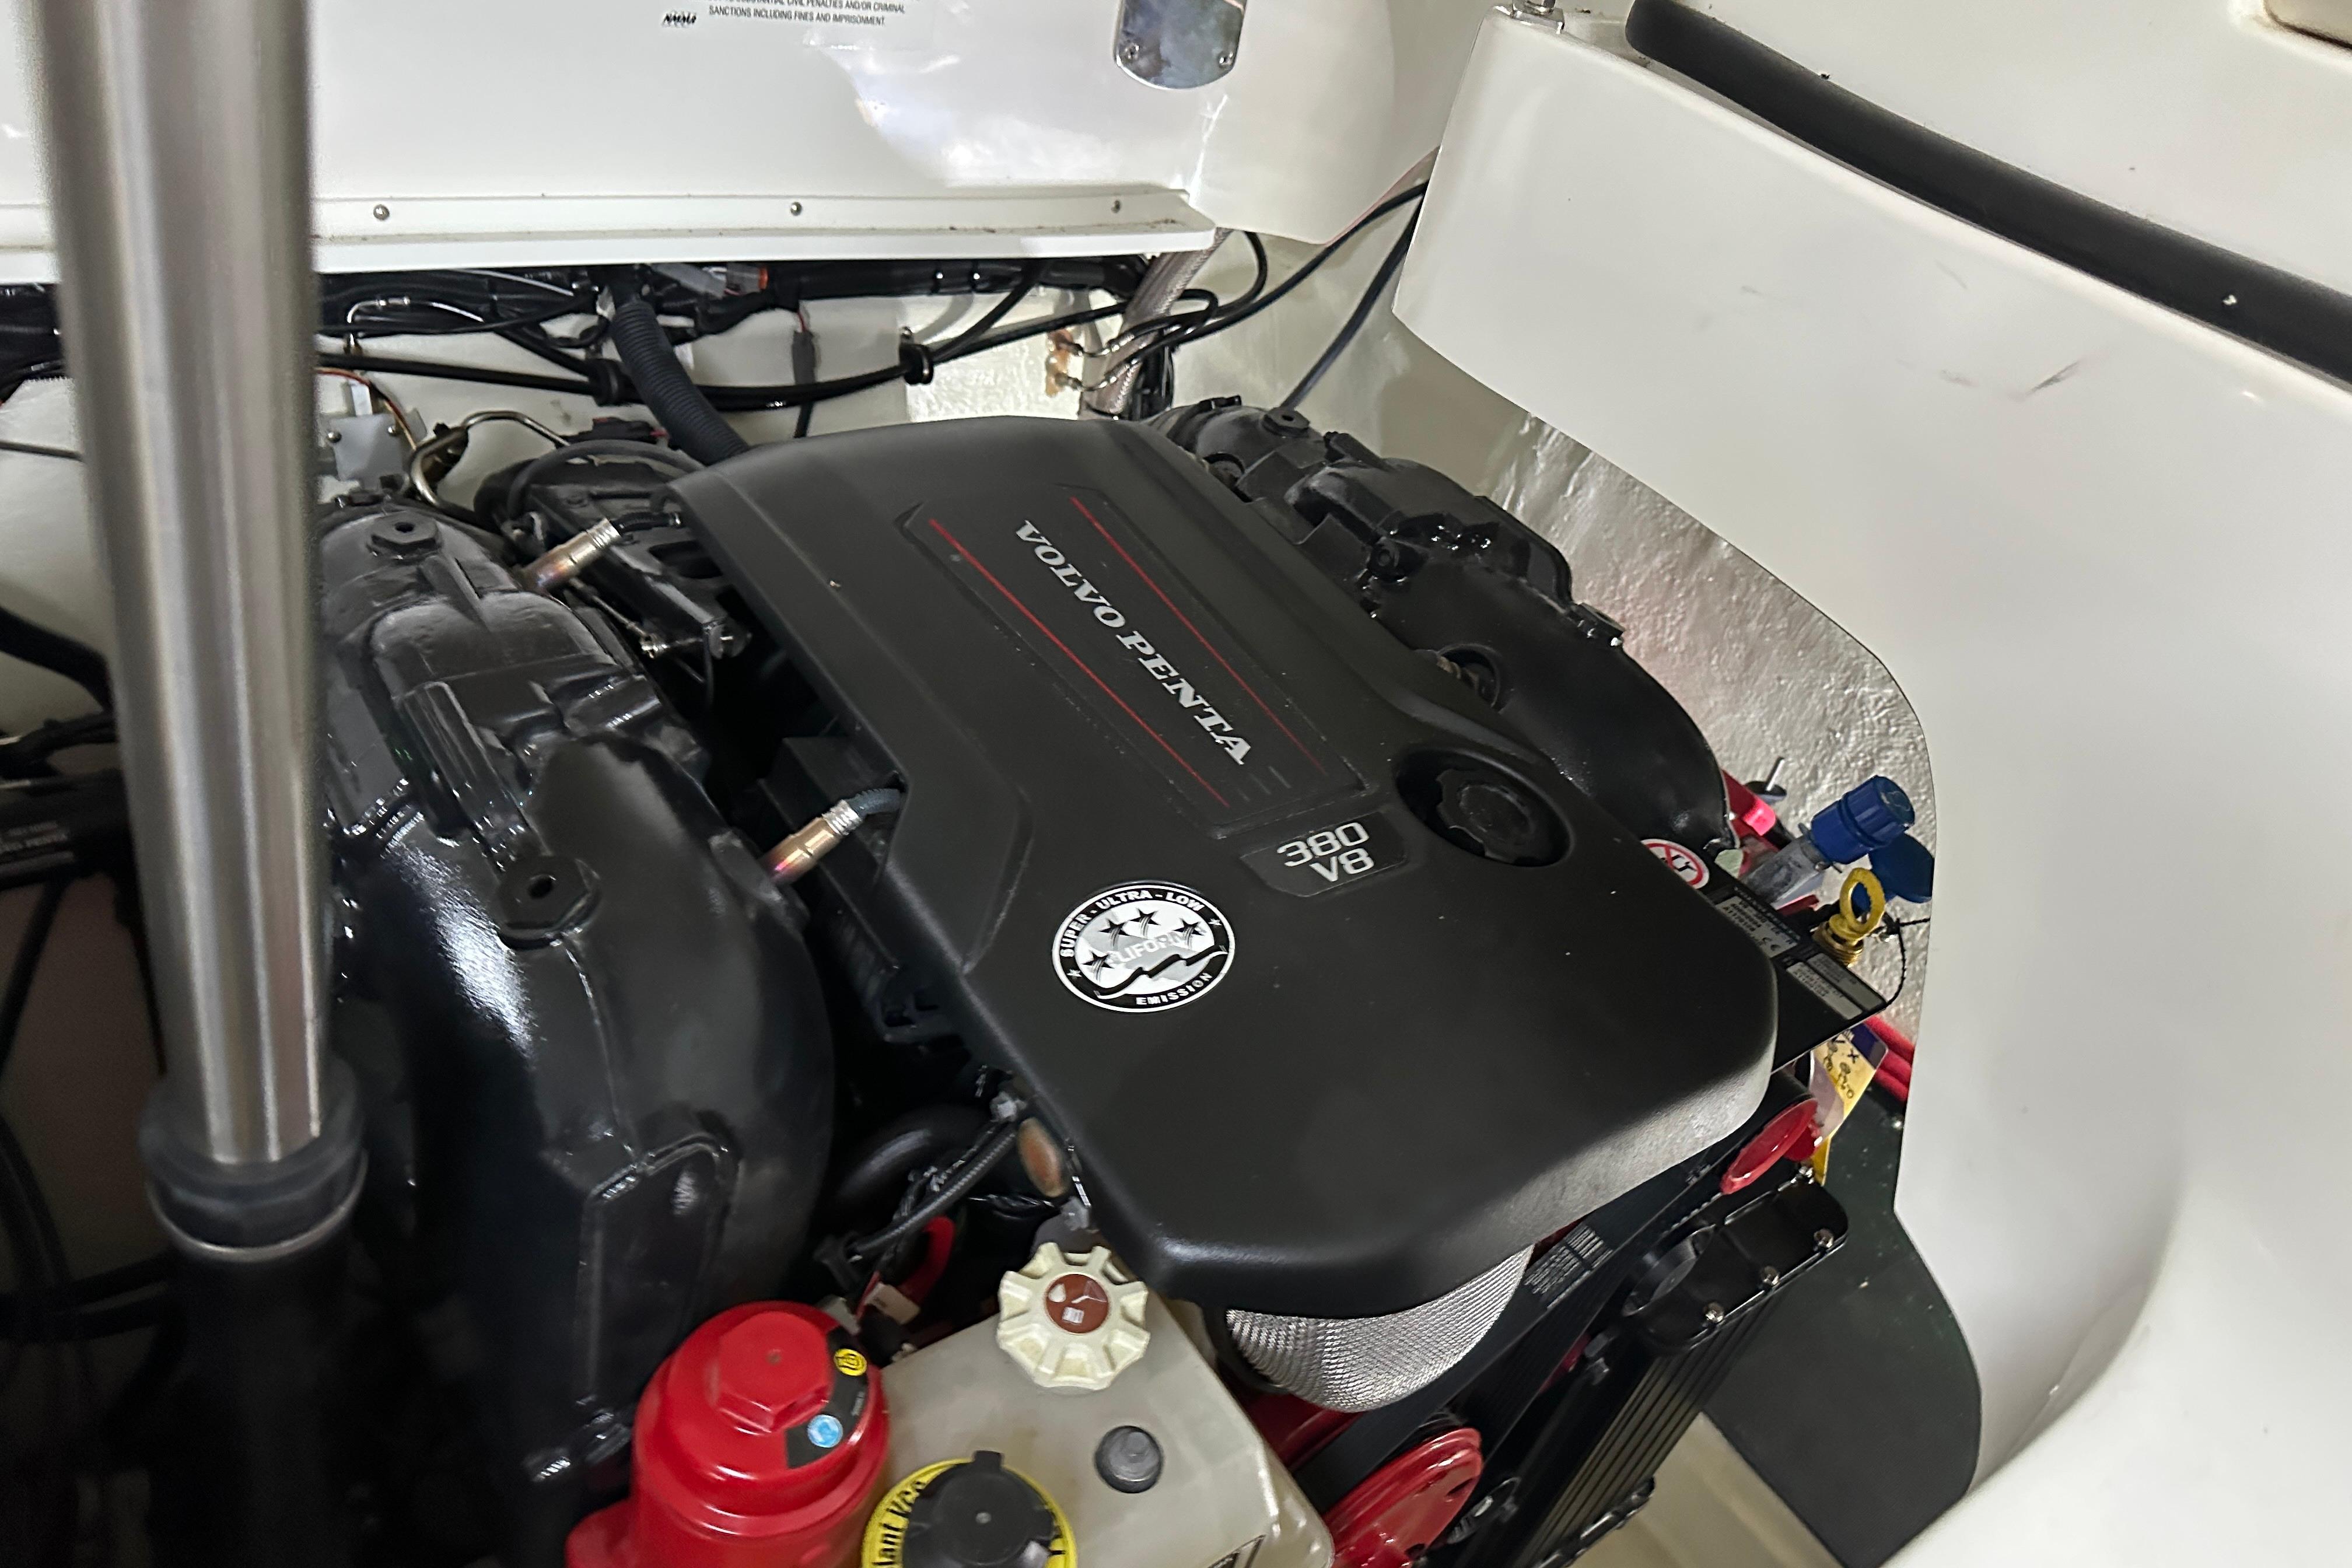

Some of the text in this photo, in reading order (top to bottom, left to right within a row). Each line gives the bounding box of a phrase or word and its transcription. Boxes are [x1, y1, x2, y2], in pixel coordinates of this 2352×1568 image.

[709, 5, 751, 18] SANCTIONS
[753, 8, 792, 20] INCLUDING
[794, 10, 814, 22] FINES
[816, 12, 831, 22] AND
[845, 1, 872, 10] AND/OR
[873, 2, 905, 14] CRIMINAL
[1016, 520, 1251, 765] VOLVO PENTA
[1276, 822, 1369, 867] 380
[1308, 848, 1374, 882] V8
[1060, 890, 1205, 957] SUPER ULTRA LOW
[1136, 972, 1213, 1005] EMISSION
